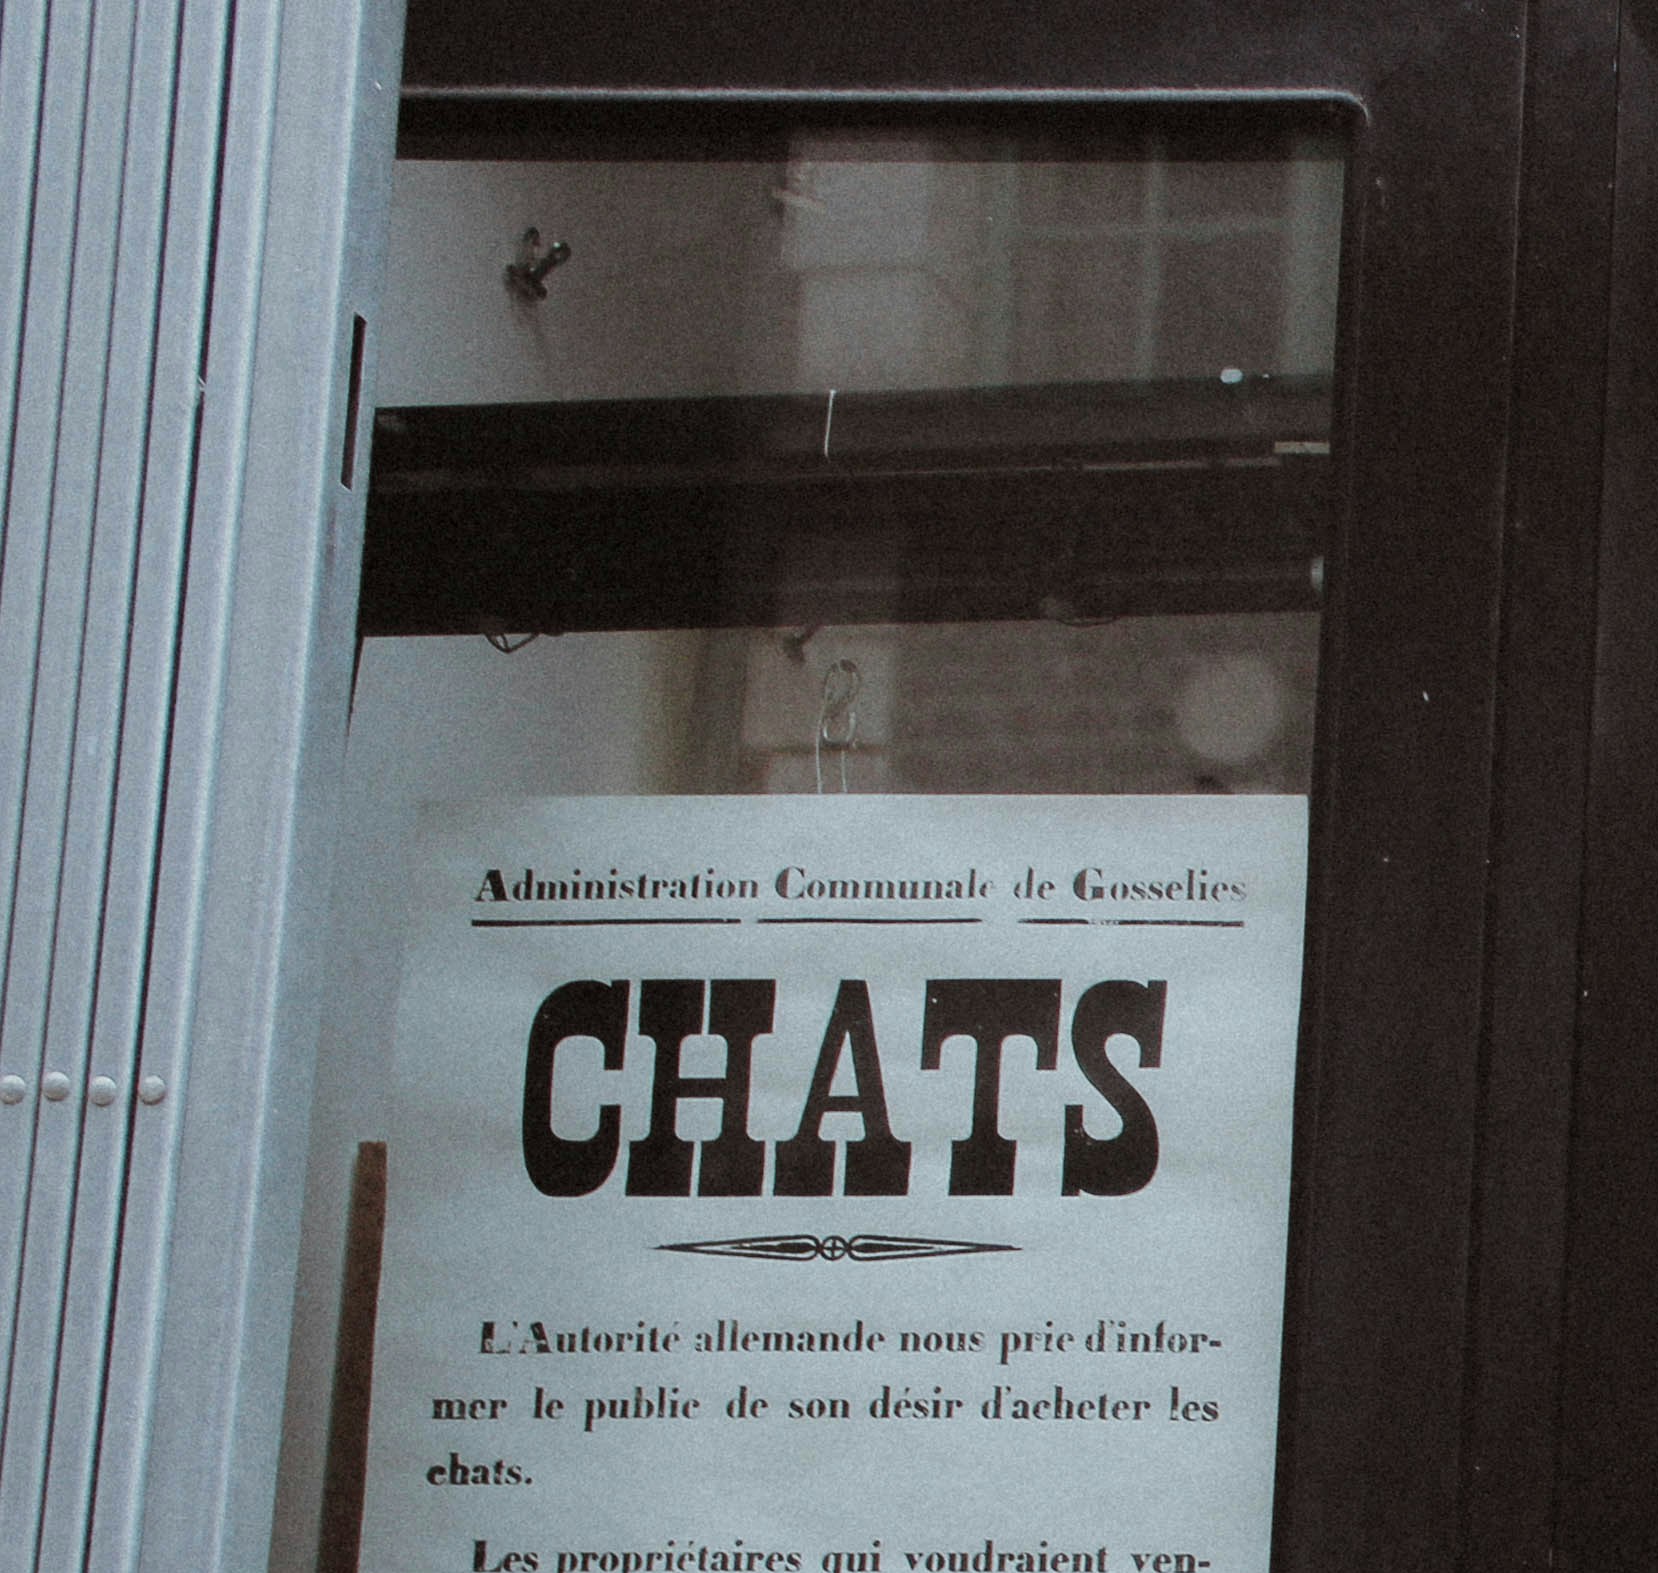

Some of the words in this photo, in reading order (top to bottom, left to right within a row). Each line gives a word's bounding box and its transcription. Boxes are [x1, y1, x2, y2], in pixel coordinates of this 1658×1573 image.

[473, 868, 757, 902] Administration
[775, 867, 994, 899] Communale
[1014, 867, 1055, 899] de
[1073, 868, 1246, 901] Gosselies
[521, 978, 1167, 1197] CHATS
[479, 1321, 679, 1354] L'Autorité
[695, 1320, 885, 1352] allemande
[900, 1332, 983, 1352] nous
[1000, 1321, 1074, 1365] prie
[1085, 1320, 1221, 1353] d'infor-
[432, 1399, 507, 1420] mer
[533, 1387, 564, 1419] le
[584, 1387, 699, 1432] public
[726, 1386, 768, 1418] de
[789, 1399, 849, 1418] son
[869, 1385, 963, 1418] désir
[981, 1386, 1151, 1420] d'acheter
[1170, 1386, 1218, 1421] les
[426, 1452, 532, 1486] chats.
[473, 1540, 538, 1572] Les
[905, 1540, 1106, 1573] voudraient
[1131, 1553, 1210, 1573] ven-
